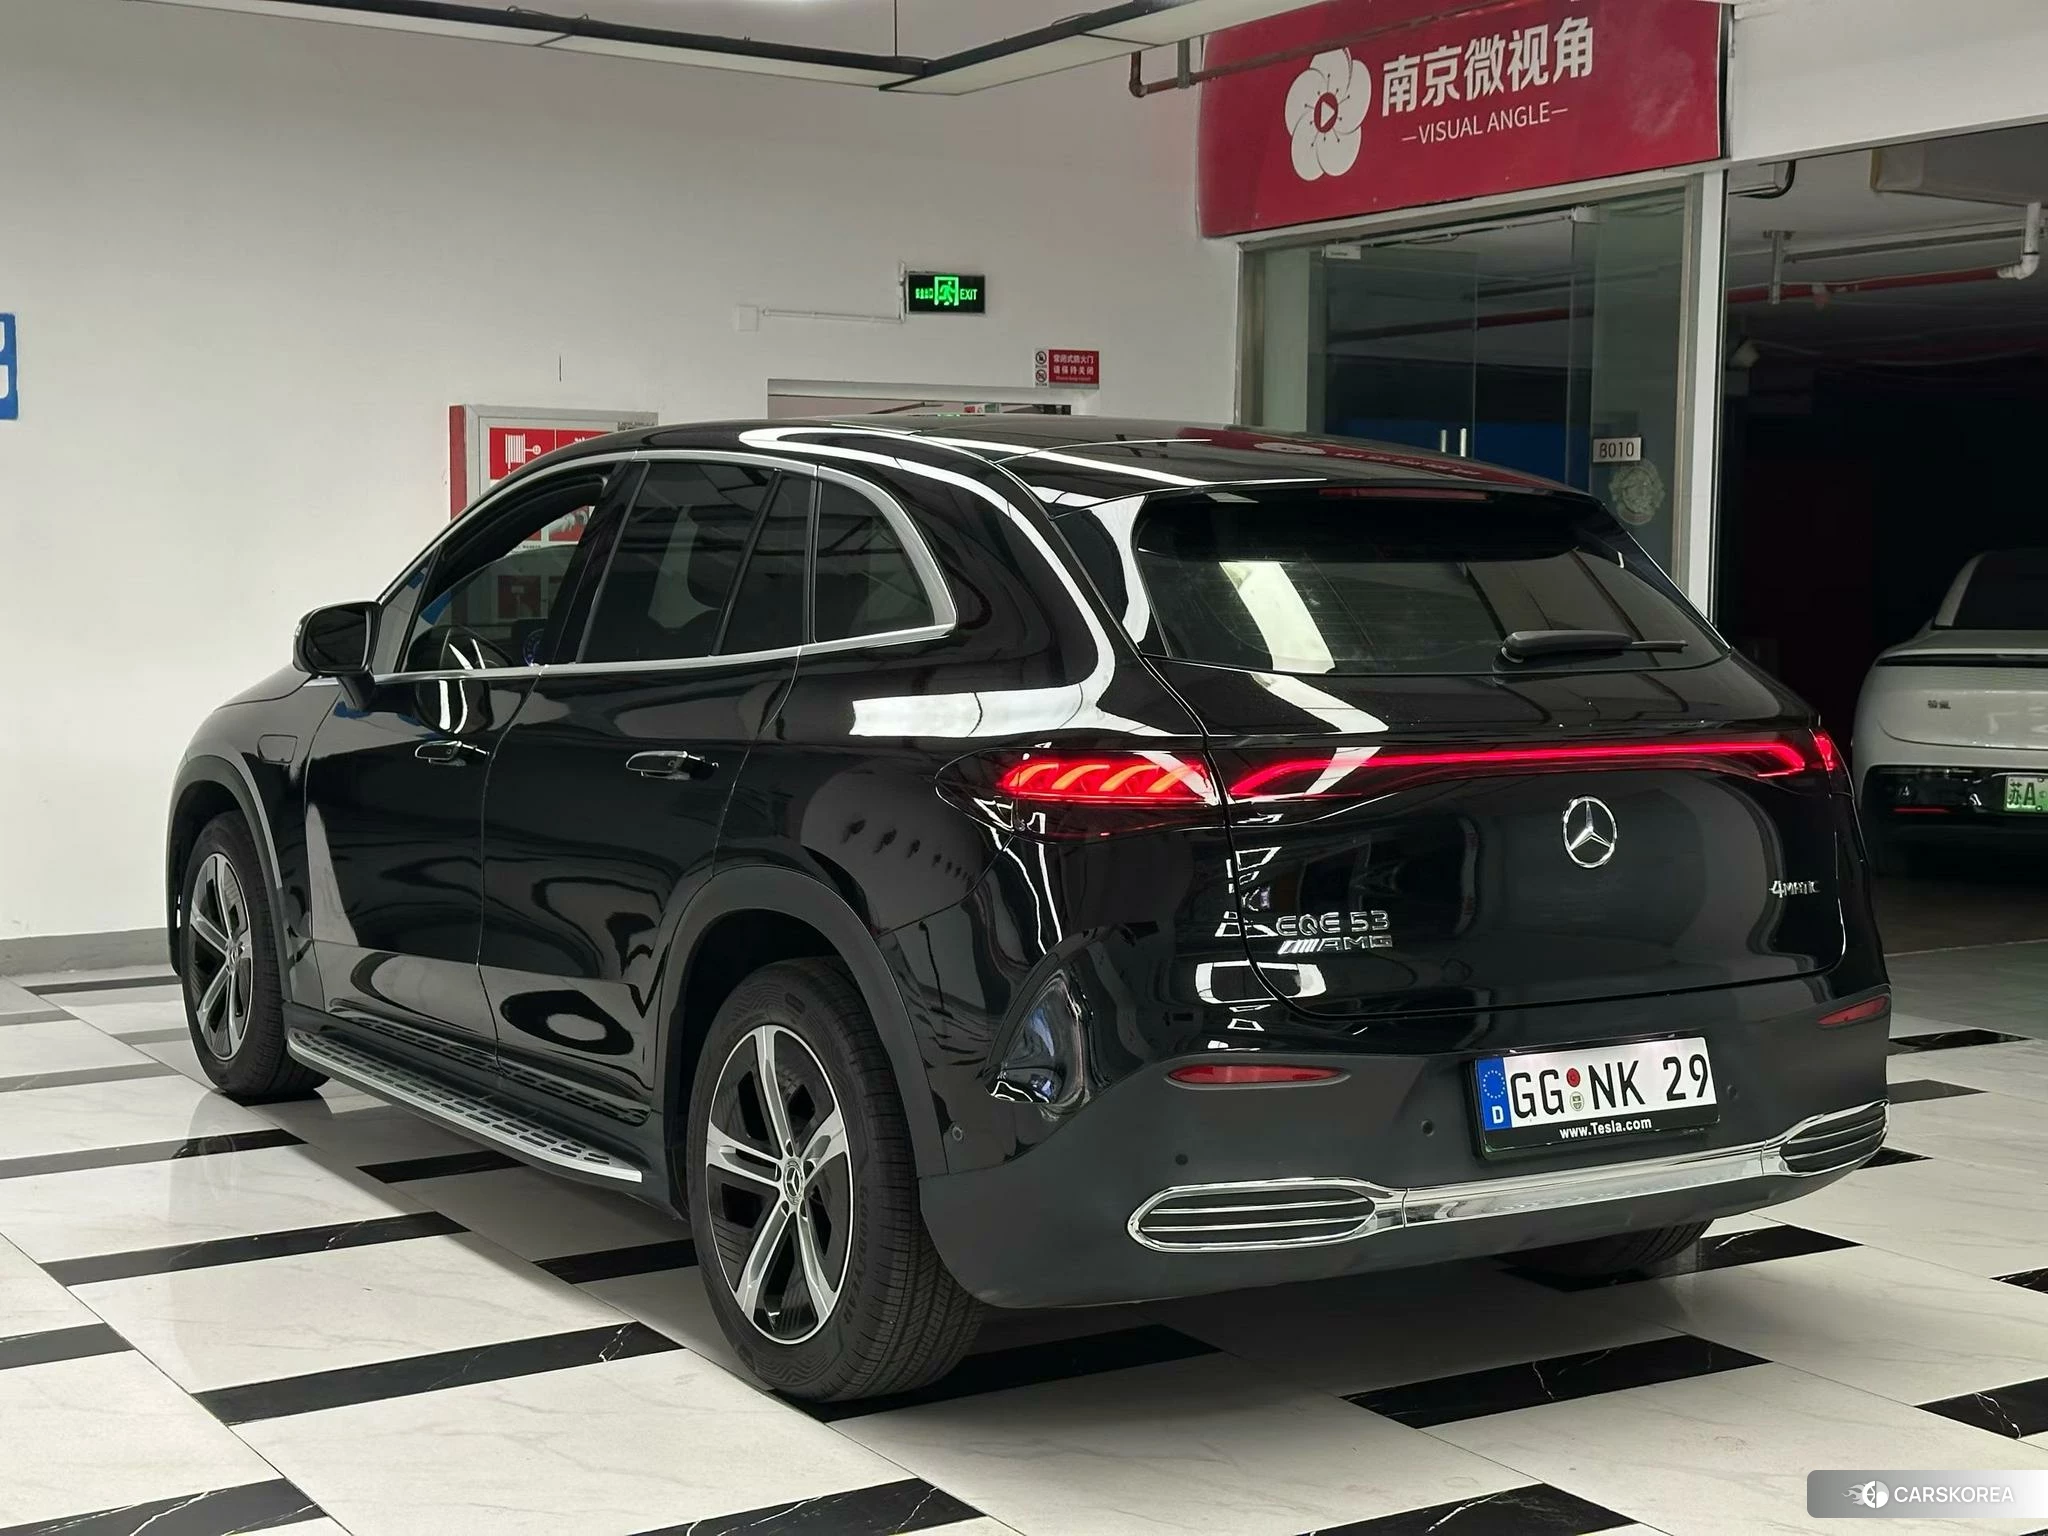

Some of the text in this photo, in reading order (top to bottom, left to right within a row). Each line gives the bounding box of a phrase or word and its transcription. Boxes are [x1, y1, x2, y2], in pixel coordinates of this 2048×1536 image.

[1381, 15, 1594, 117] 南京微视角
[1418, 102, 1551, 144] VISUAL ANGLE
[960, 288, 978, 300] EXIT
[1275, 910, 1390, 936] EQE 53
[1316, 935, 1393, 952] AMG
[1510, 1053, 1708, 1119] GG NK 29
[1491, 1105, 1505, 1124] D
[1559, 1117, 1652, 1140] www.Tesla.com
